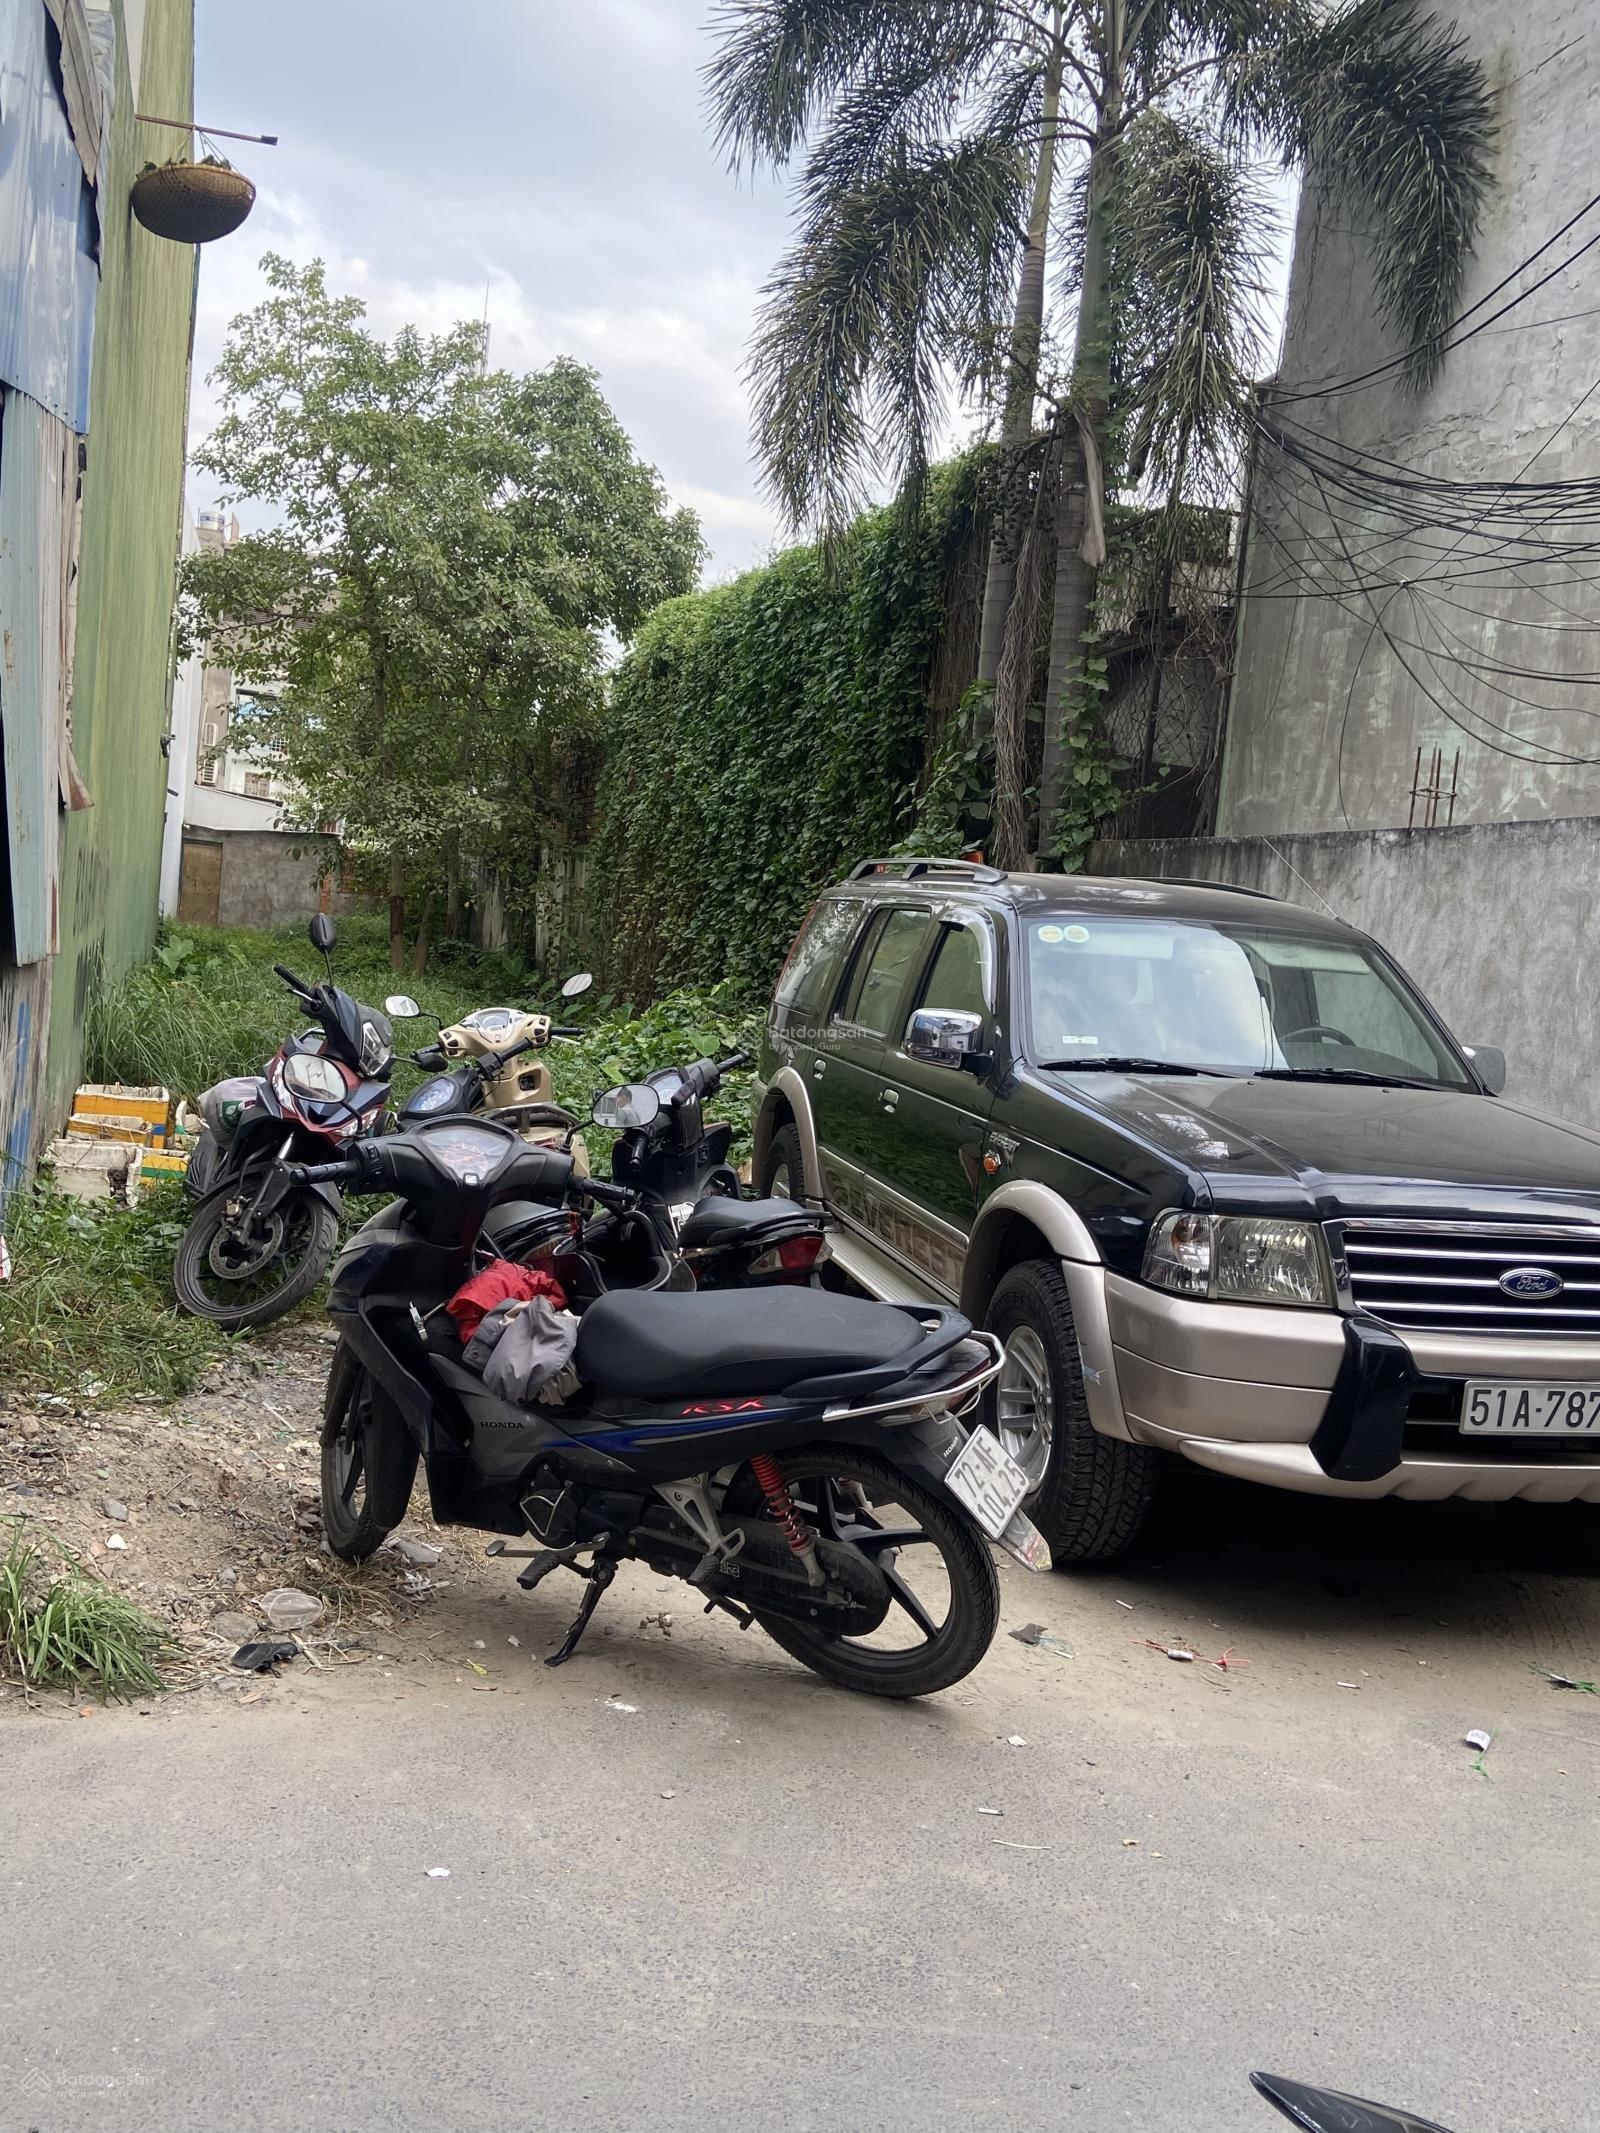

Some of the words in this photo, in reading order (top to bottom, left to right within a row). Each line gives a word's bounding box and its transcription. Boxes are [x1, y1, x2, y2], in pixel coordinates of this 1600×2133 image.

[1516, 1275, 1549, 1291] Ford
[678, 1397, 768, 1417] RSX
[1470, 1389, 1600, 1429] 51A-787
[480, 1421, 525, 1430] HONDA
[954, 1436, 998, 1499] 72-AF
[977, 1458, 1028, 1530] 104.25
